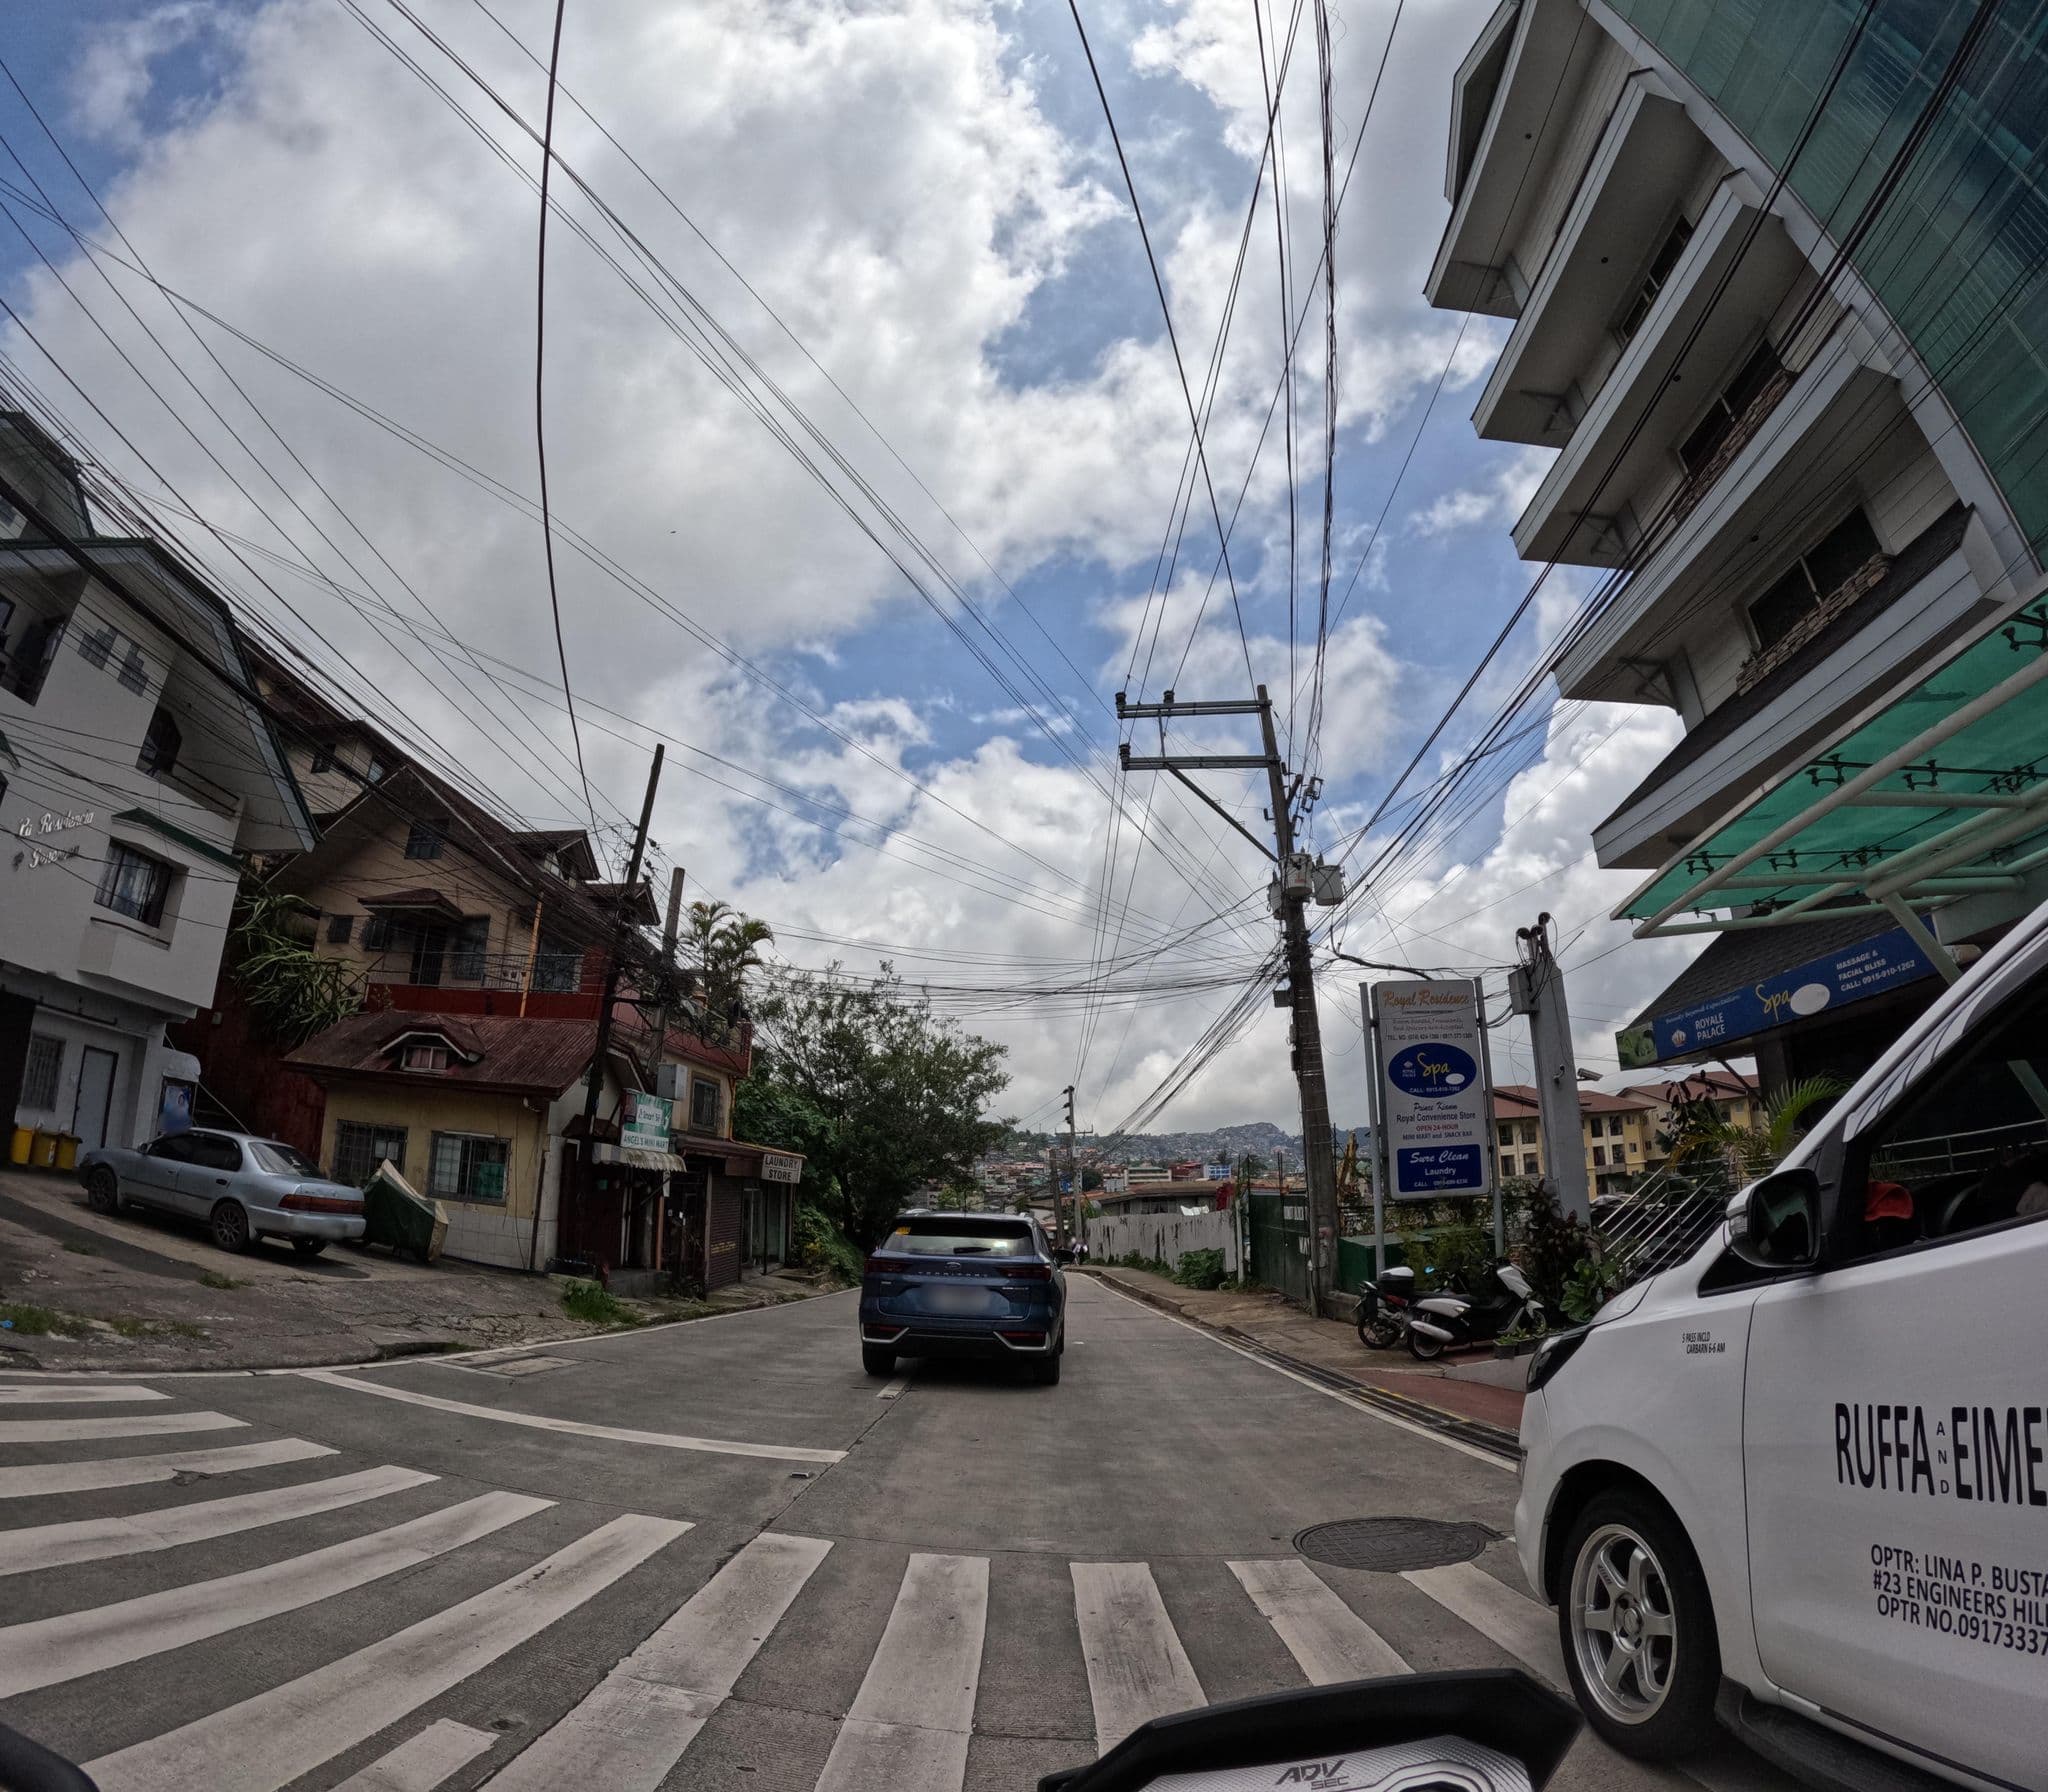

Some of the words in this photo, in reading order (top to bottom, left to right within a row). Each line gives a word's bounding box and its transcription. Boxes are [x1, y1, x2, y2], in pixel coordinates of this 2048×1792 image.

[1836, 951, 1871, 970] MASSAGE
[1872, 949, 1879, 957] &
[1838, 968, 1864, 981] FACIAL
[1864, 958, 1887, 972] BLISS
[1382, 991, 1417, 1009] Royal
[1755, 983, 1791, 1021] Spa
[1695, 1012, 1725, 1030] ROYALE
[1697, 1024, 1726, 1041] PALACE
[1417, 1052, 1450, 1085] Spa
[1396, 1114, 1415, 1124] Royal
[1417, 1112, 1459, 1121] Convenience
[1459, 1111, 1476, 1120] Store
[1416, 1124, 1432, 1132] OPEN
[765, 1155, 798, 1169] LAUNDRY
[1409, 1151, 1435, 1164] Sure
[1438, 1150, 1470, 1163] Clean
[768, 1168, 793, 1181] STORE
[1424, 1167, 1457, 1176] Laundry
[1686, 1332, 1697, 1343] PASS
[1686, 1343, 1708, 1354] CARBARN
[1717, 1342, 1726, 1353] AM
[1835, 1402, 1935, 1496] RUFFA
[1936, 1421, 1950, 1494] AND
[1952, 1406, 2048, 1507] EIME
[1871, 1544, 1919, 1575] OPTR:
[1925, 1553, 1966, 1583] LINA
[1971, 1562, 1985, 1587] P.
[1873, 1569, 1901, 1595] #23
[1907, 1578, 2007, 1619] ENGINEERS
[1877, 1594, 1920, 1626] OPTR
[1275, 1760, 1346, 1785] ADV
[1311, 1775, 1349, 1790] SEC
